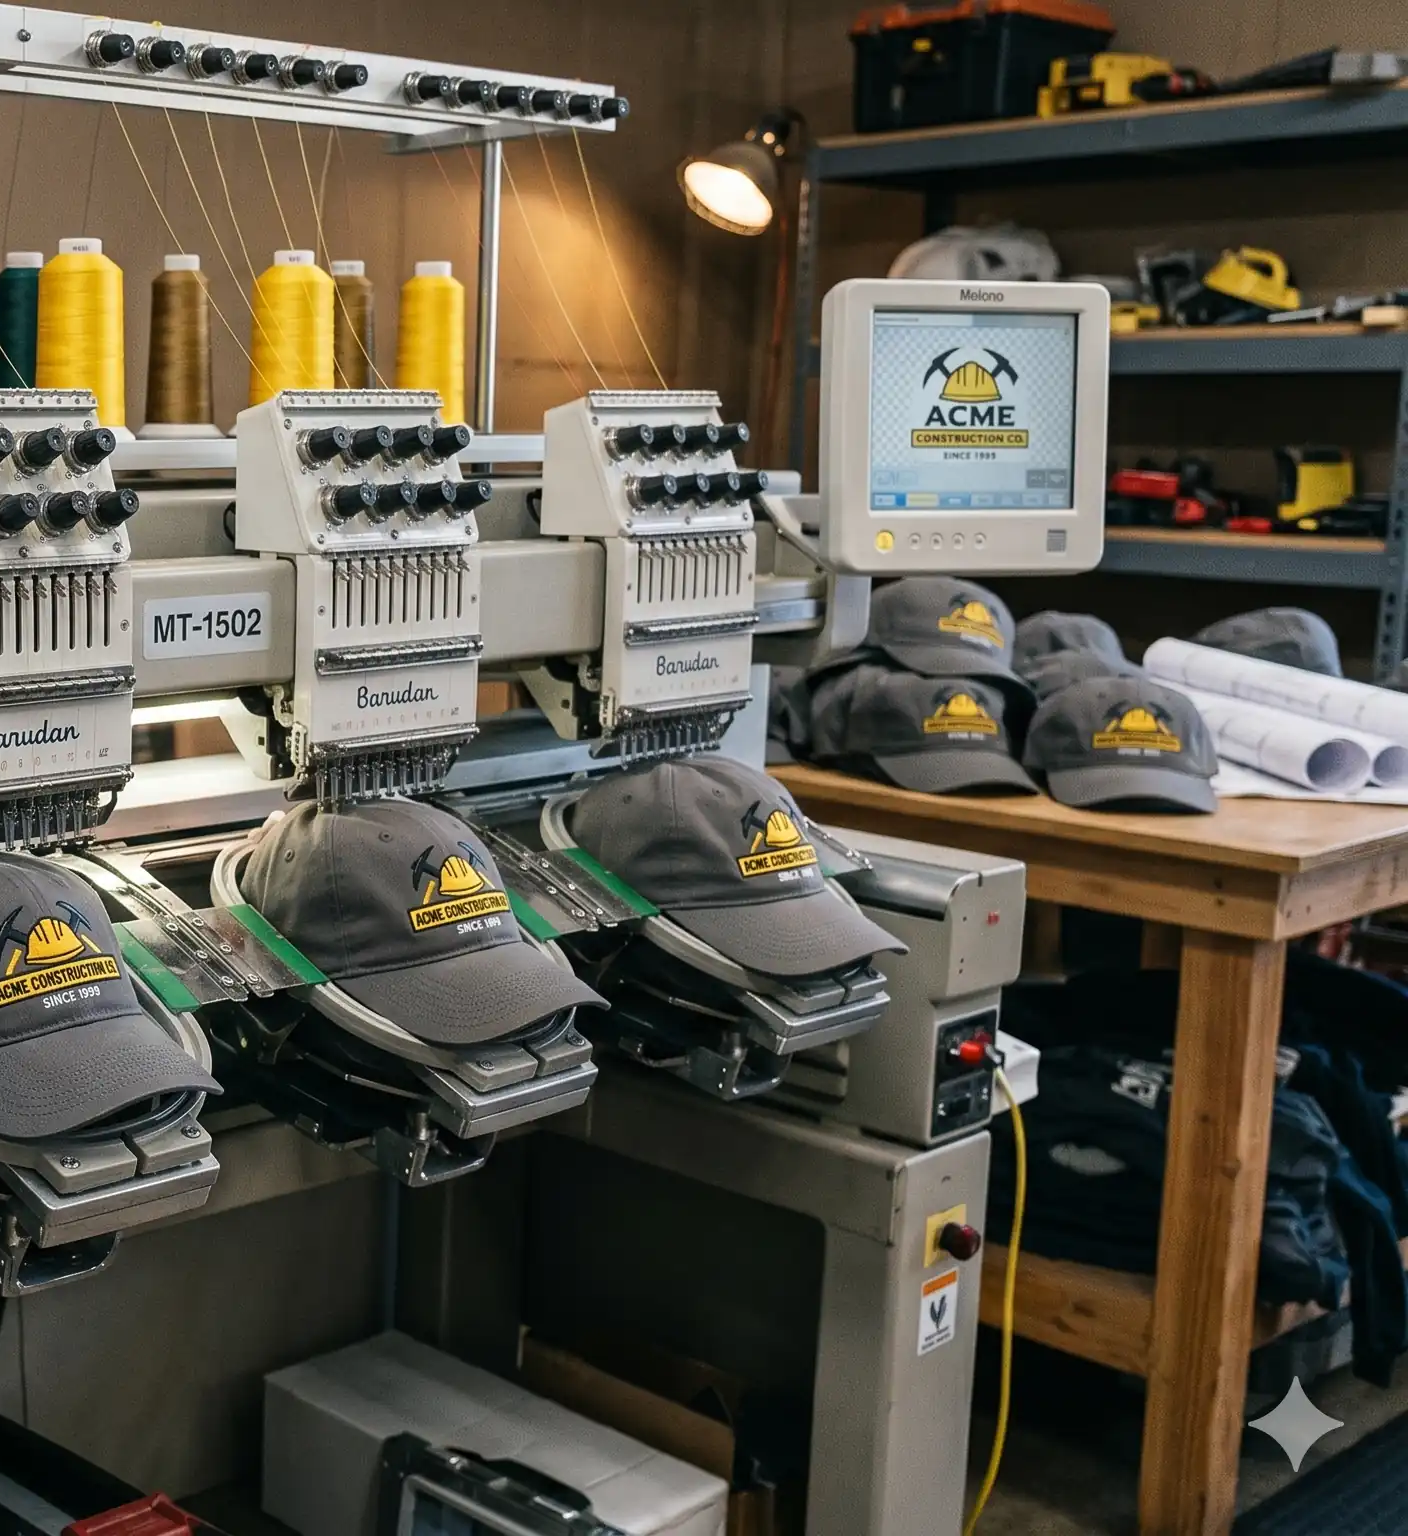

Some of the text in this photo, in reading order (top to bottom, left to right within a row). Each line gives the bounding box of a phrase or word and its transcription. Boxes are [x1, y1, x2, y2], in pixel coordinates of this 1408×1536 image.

[924, 405, 1016, 427] ACME
[915, 433, 1024, 444] CONSTRUCTION CO.
[153, 608, 262, 644] MT-1502
[656, 650, 720, 676] Barudan
[357, 680, 439, 709] Barudan
[43, 985, 101, 1009] SINCE 1999
